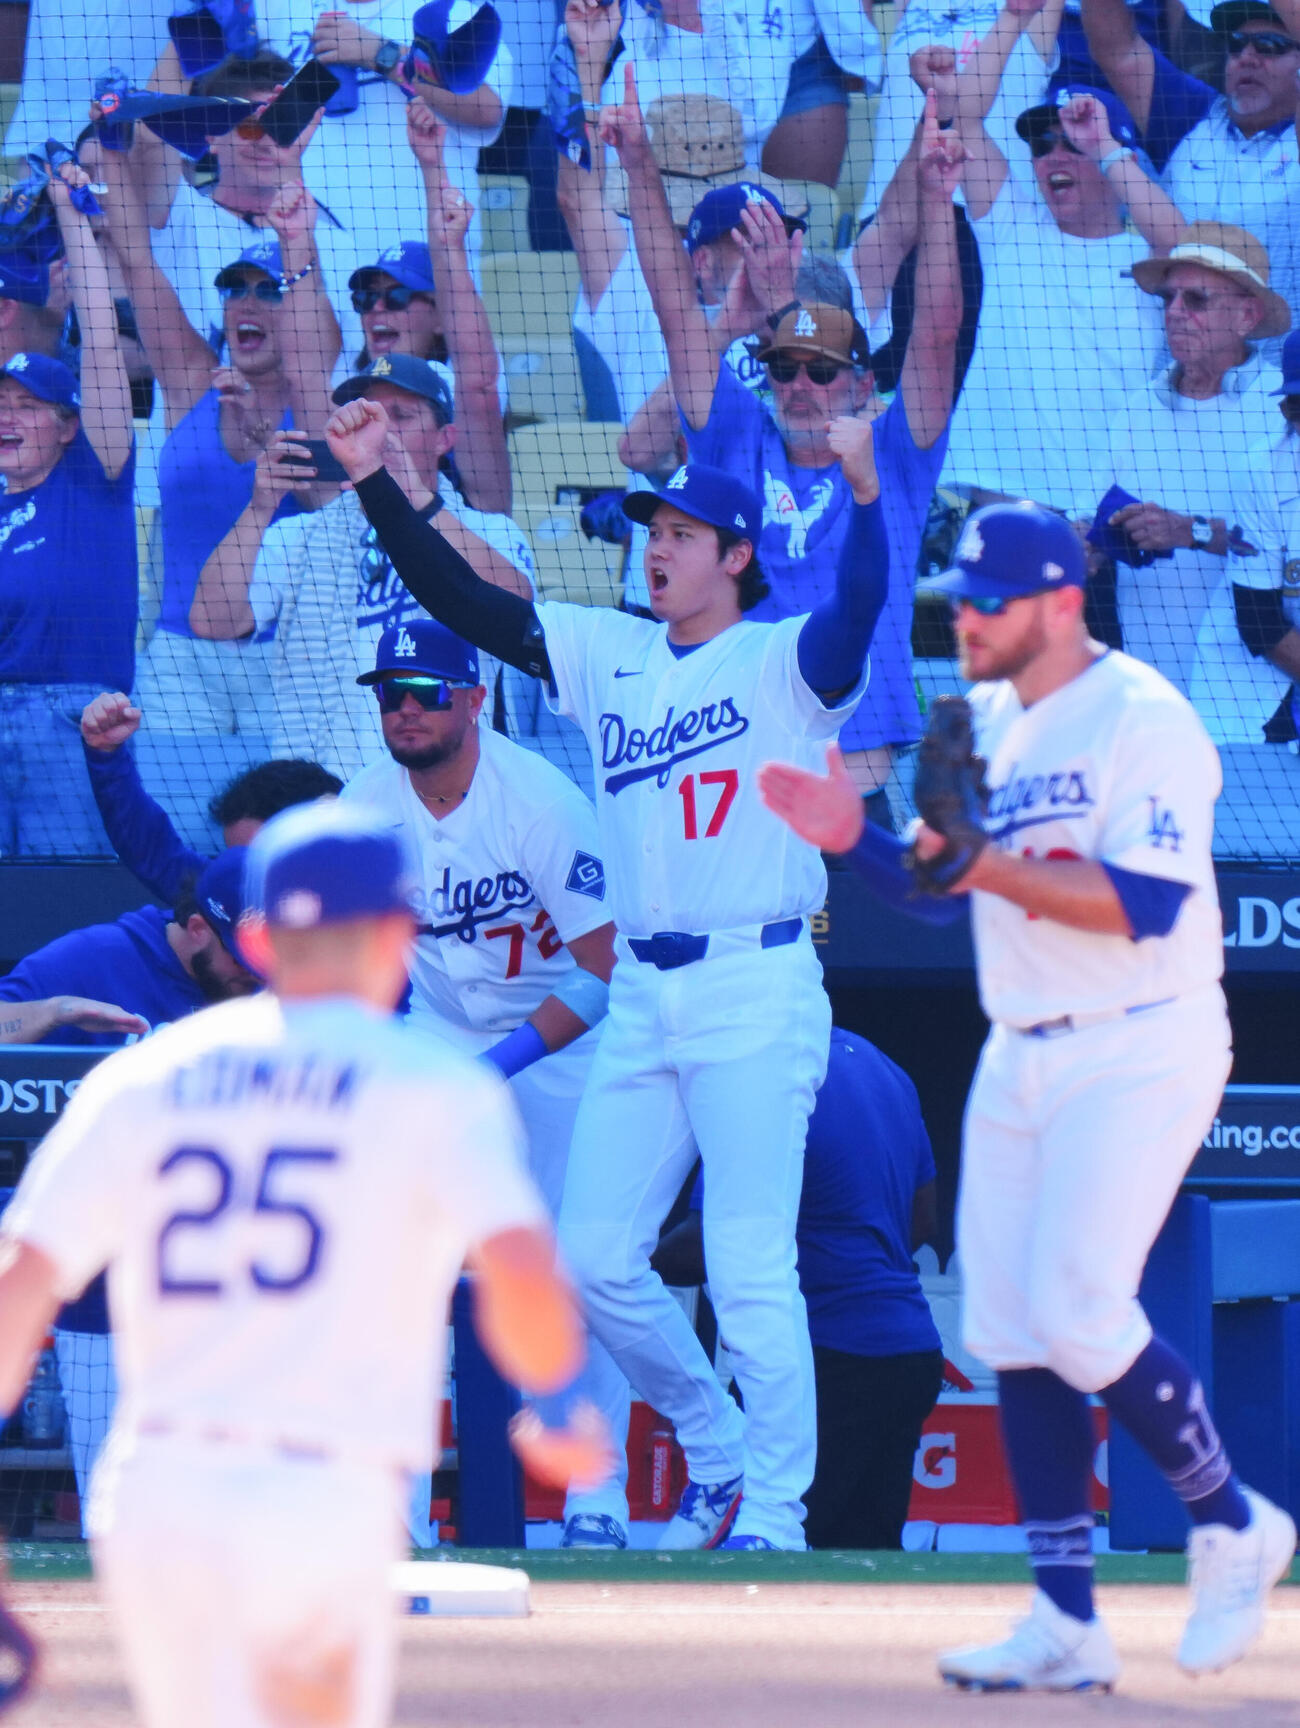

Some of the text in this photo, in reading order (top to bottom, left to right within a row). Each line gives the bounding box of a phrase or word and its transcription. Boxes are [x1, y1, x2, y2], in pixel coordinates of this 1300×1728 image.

[795, 310, 817, 335] LA
[7, 352, 30, 372] LA
[371, 356, 392, 377] LA
[667, 465, 689, 489] LA
[394, 627, 417, 657] LA
[600, 697, 748, 792] Dodgers
[678, 769, 739, 841] 17
[1147, 795, 1185, 853] LA
[484, 909, 566, 980] 72
[1222, 896, 1300, 949] DS
[158, 1147, 340, 1292] 25
[652, 1445, 665, 1506] GATORADE
[912, 1433, 957, 1490] G
